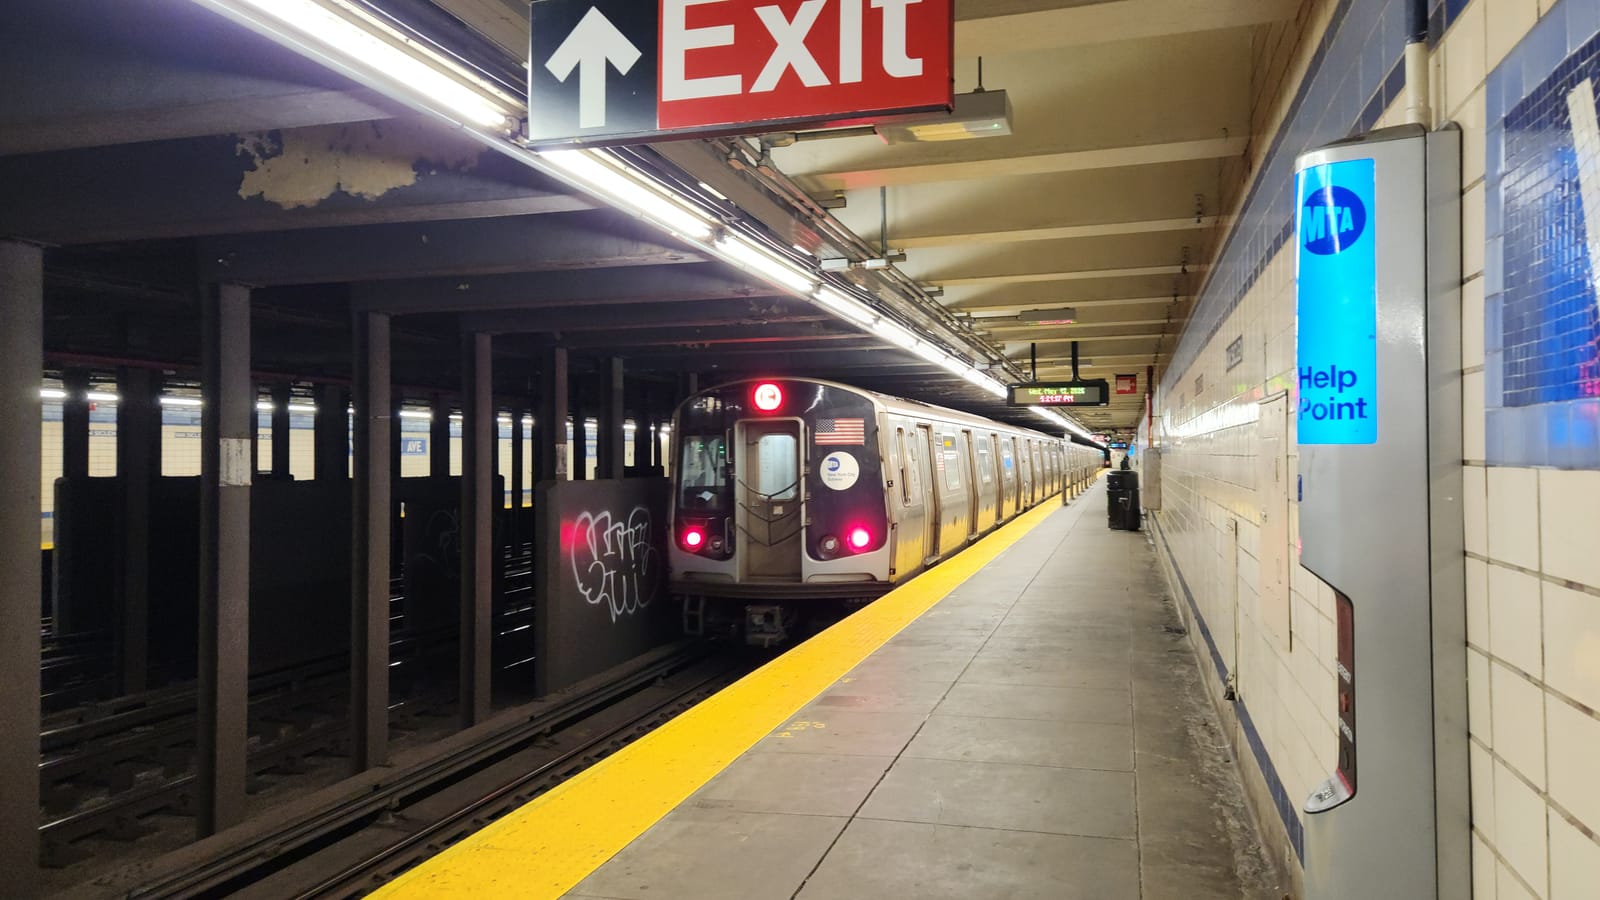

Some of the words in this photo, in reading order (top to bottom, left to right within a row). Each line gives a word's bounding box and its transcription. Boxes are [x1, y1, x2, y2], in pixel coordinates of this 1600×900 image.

[661, 0, 924, 102] Exit
[1303, 205, 1355, 246] MTA
[1299, 365, 1358, 394] Help
[1299, 396, 1368, 421] Point
[407, 440, 423, 453] AVE
